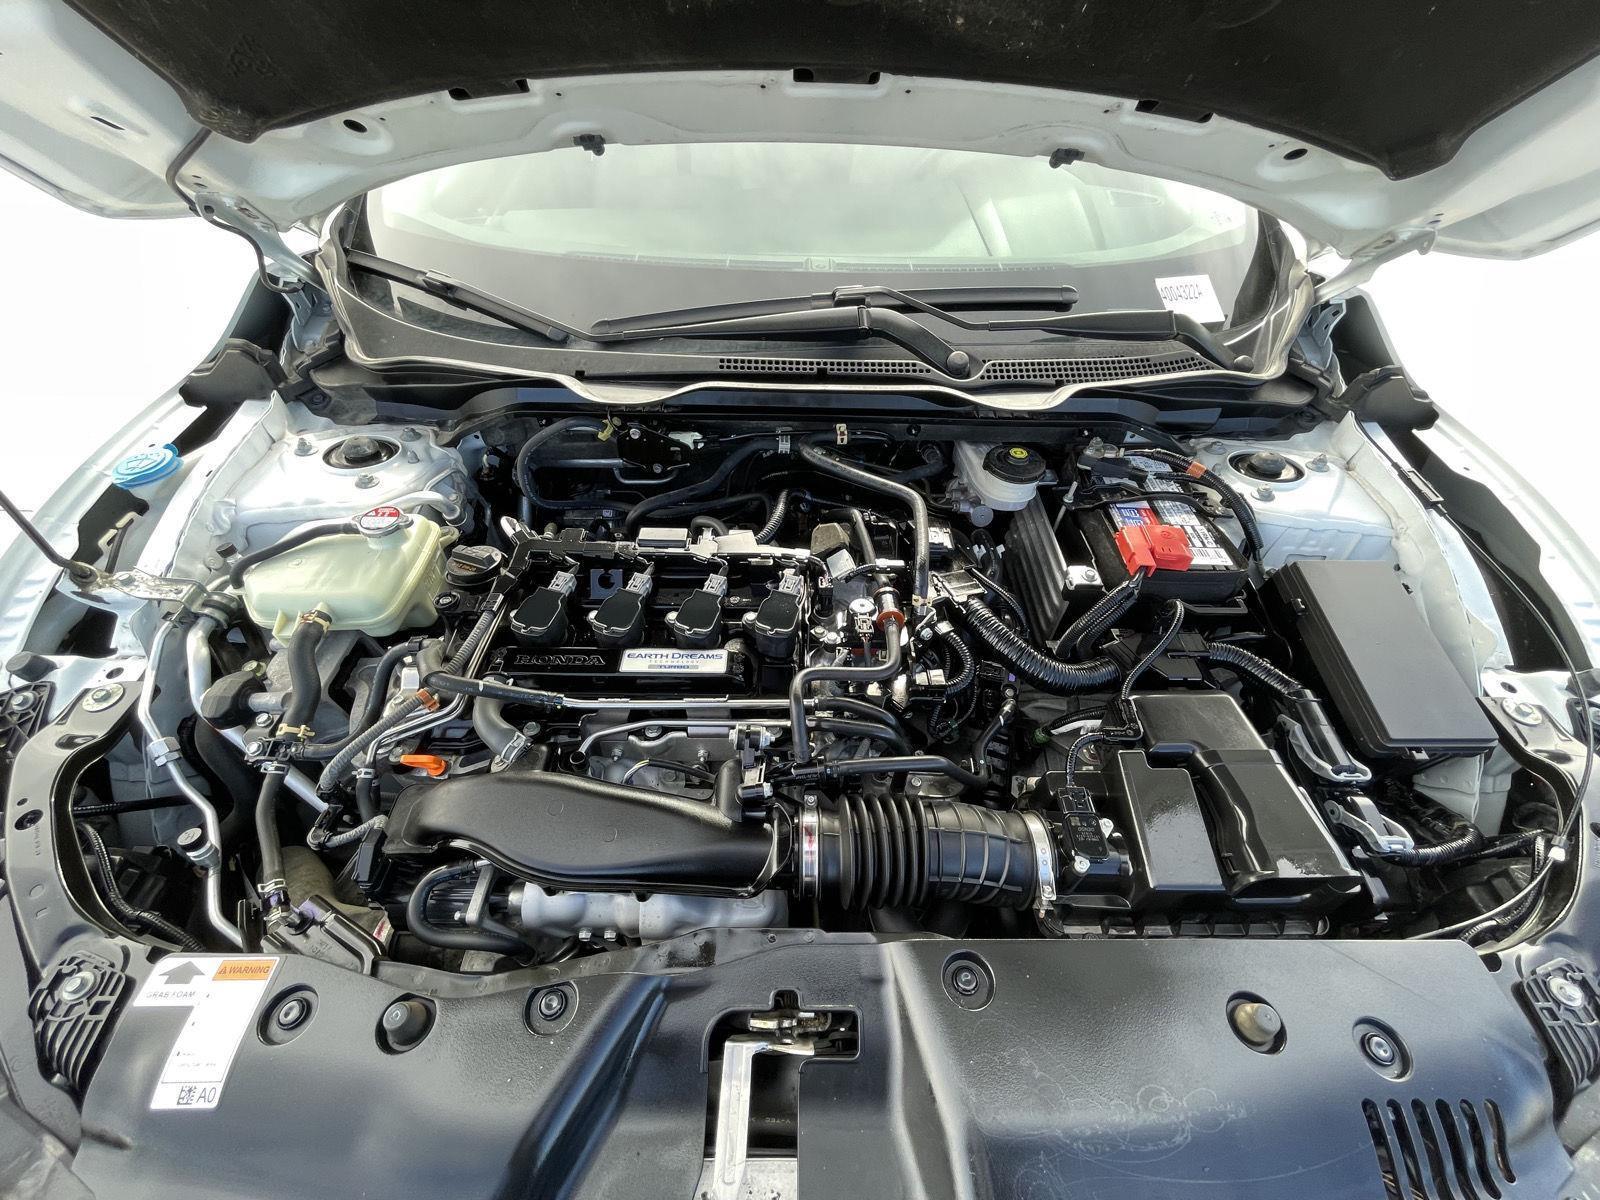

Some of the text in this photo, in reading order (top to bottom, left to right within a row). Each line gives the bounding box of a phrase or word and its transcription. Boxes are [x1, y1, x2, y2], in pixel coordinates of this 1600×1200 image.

[514, 654, 606, 666] HONDA
[668, 652, 724, 660] DREAMS
[228, 965, 271, 975] WARNING
